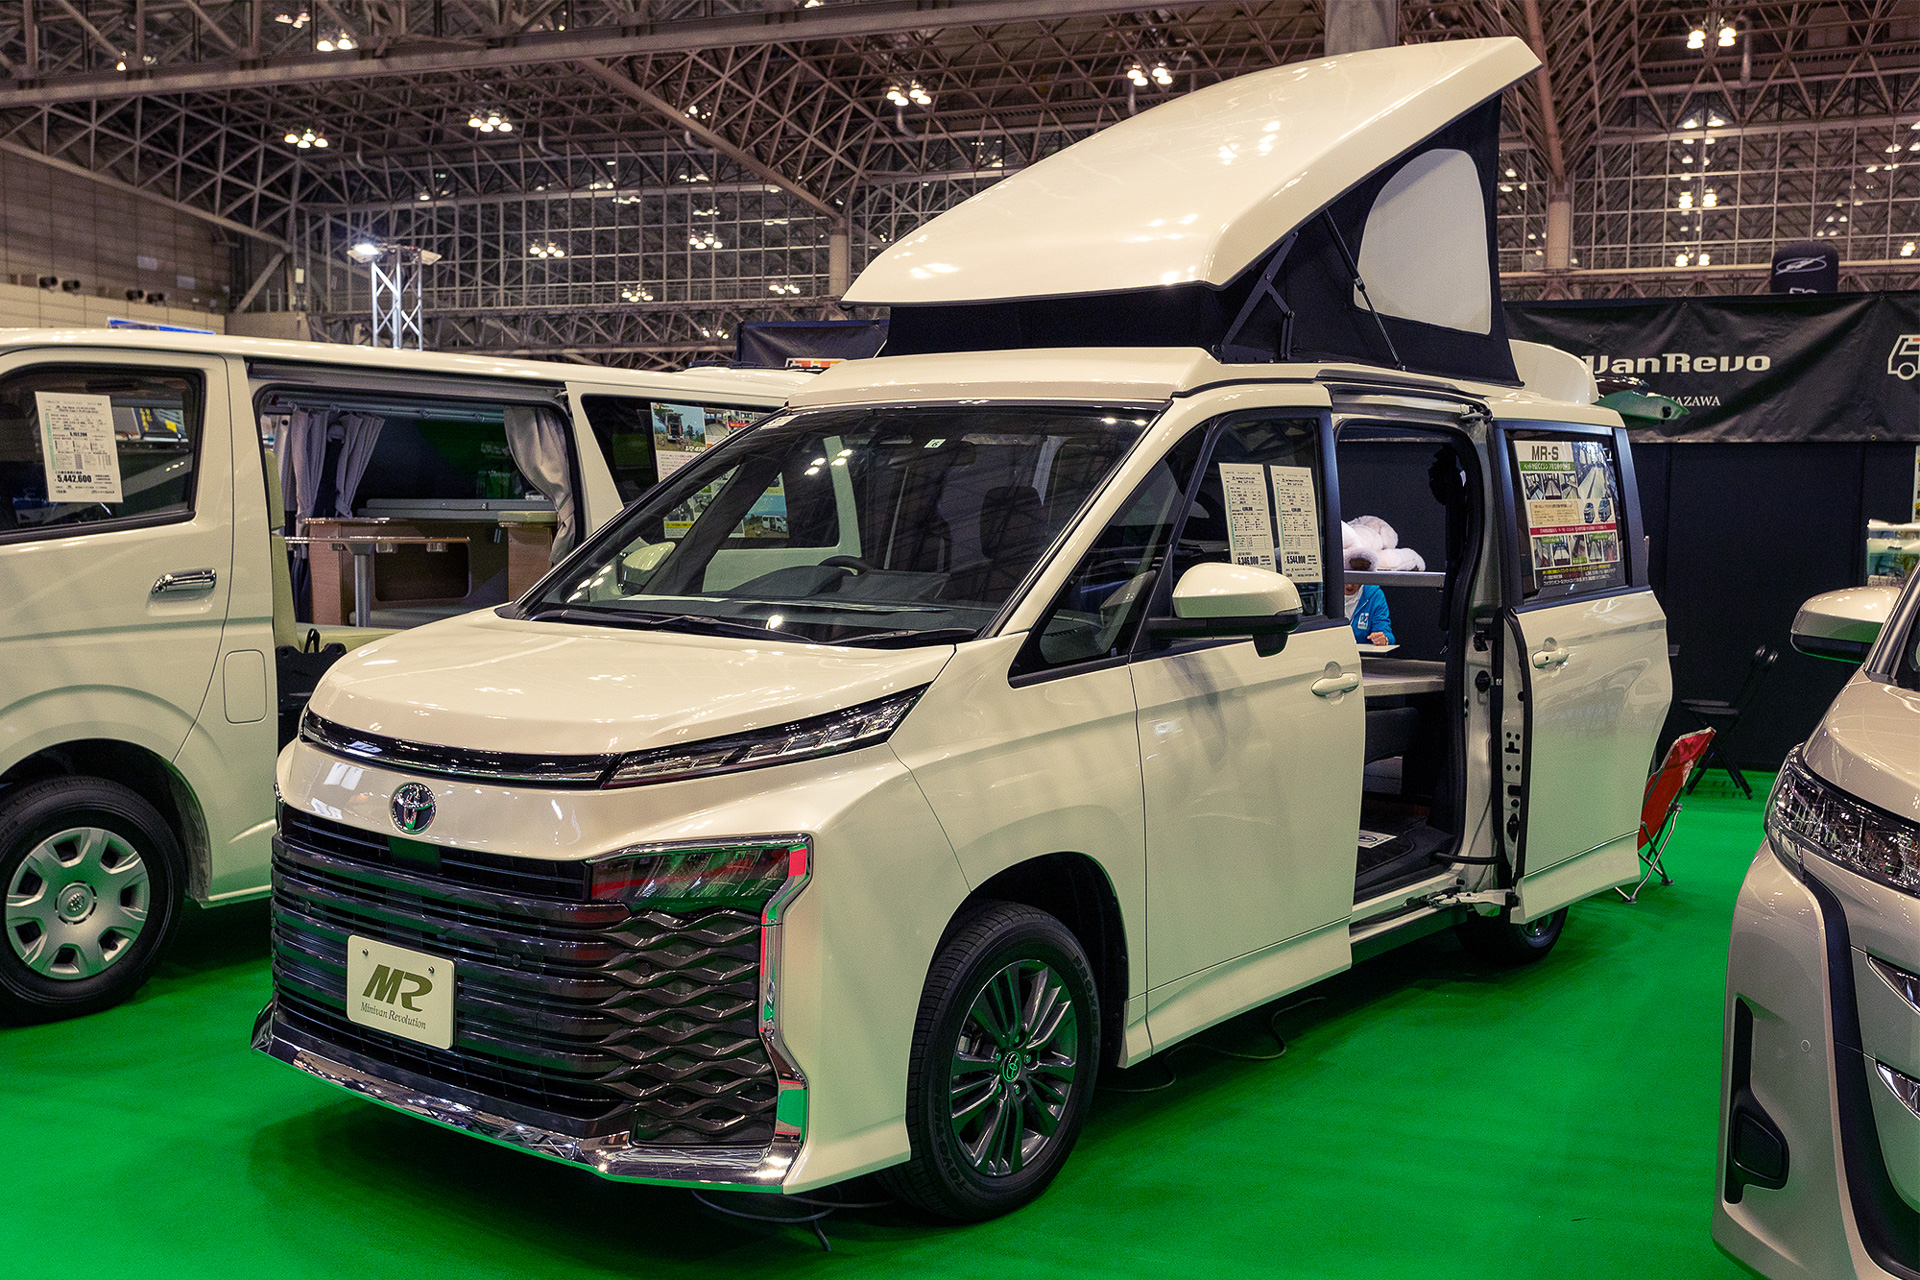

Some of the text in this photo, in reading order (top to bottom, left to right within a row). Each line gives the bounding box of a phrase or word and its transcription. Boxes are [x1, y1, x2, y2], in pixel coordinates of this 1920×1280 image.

[1581, 352, 1771, 375] VanRevo
[1531, 445, 1559, 461] MR-S
[57, 474, 92, 483] 5,442,600
[362, 963, 433, 1013] MR
[360, 1001, 426, 1030] Minivan Revolution
